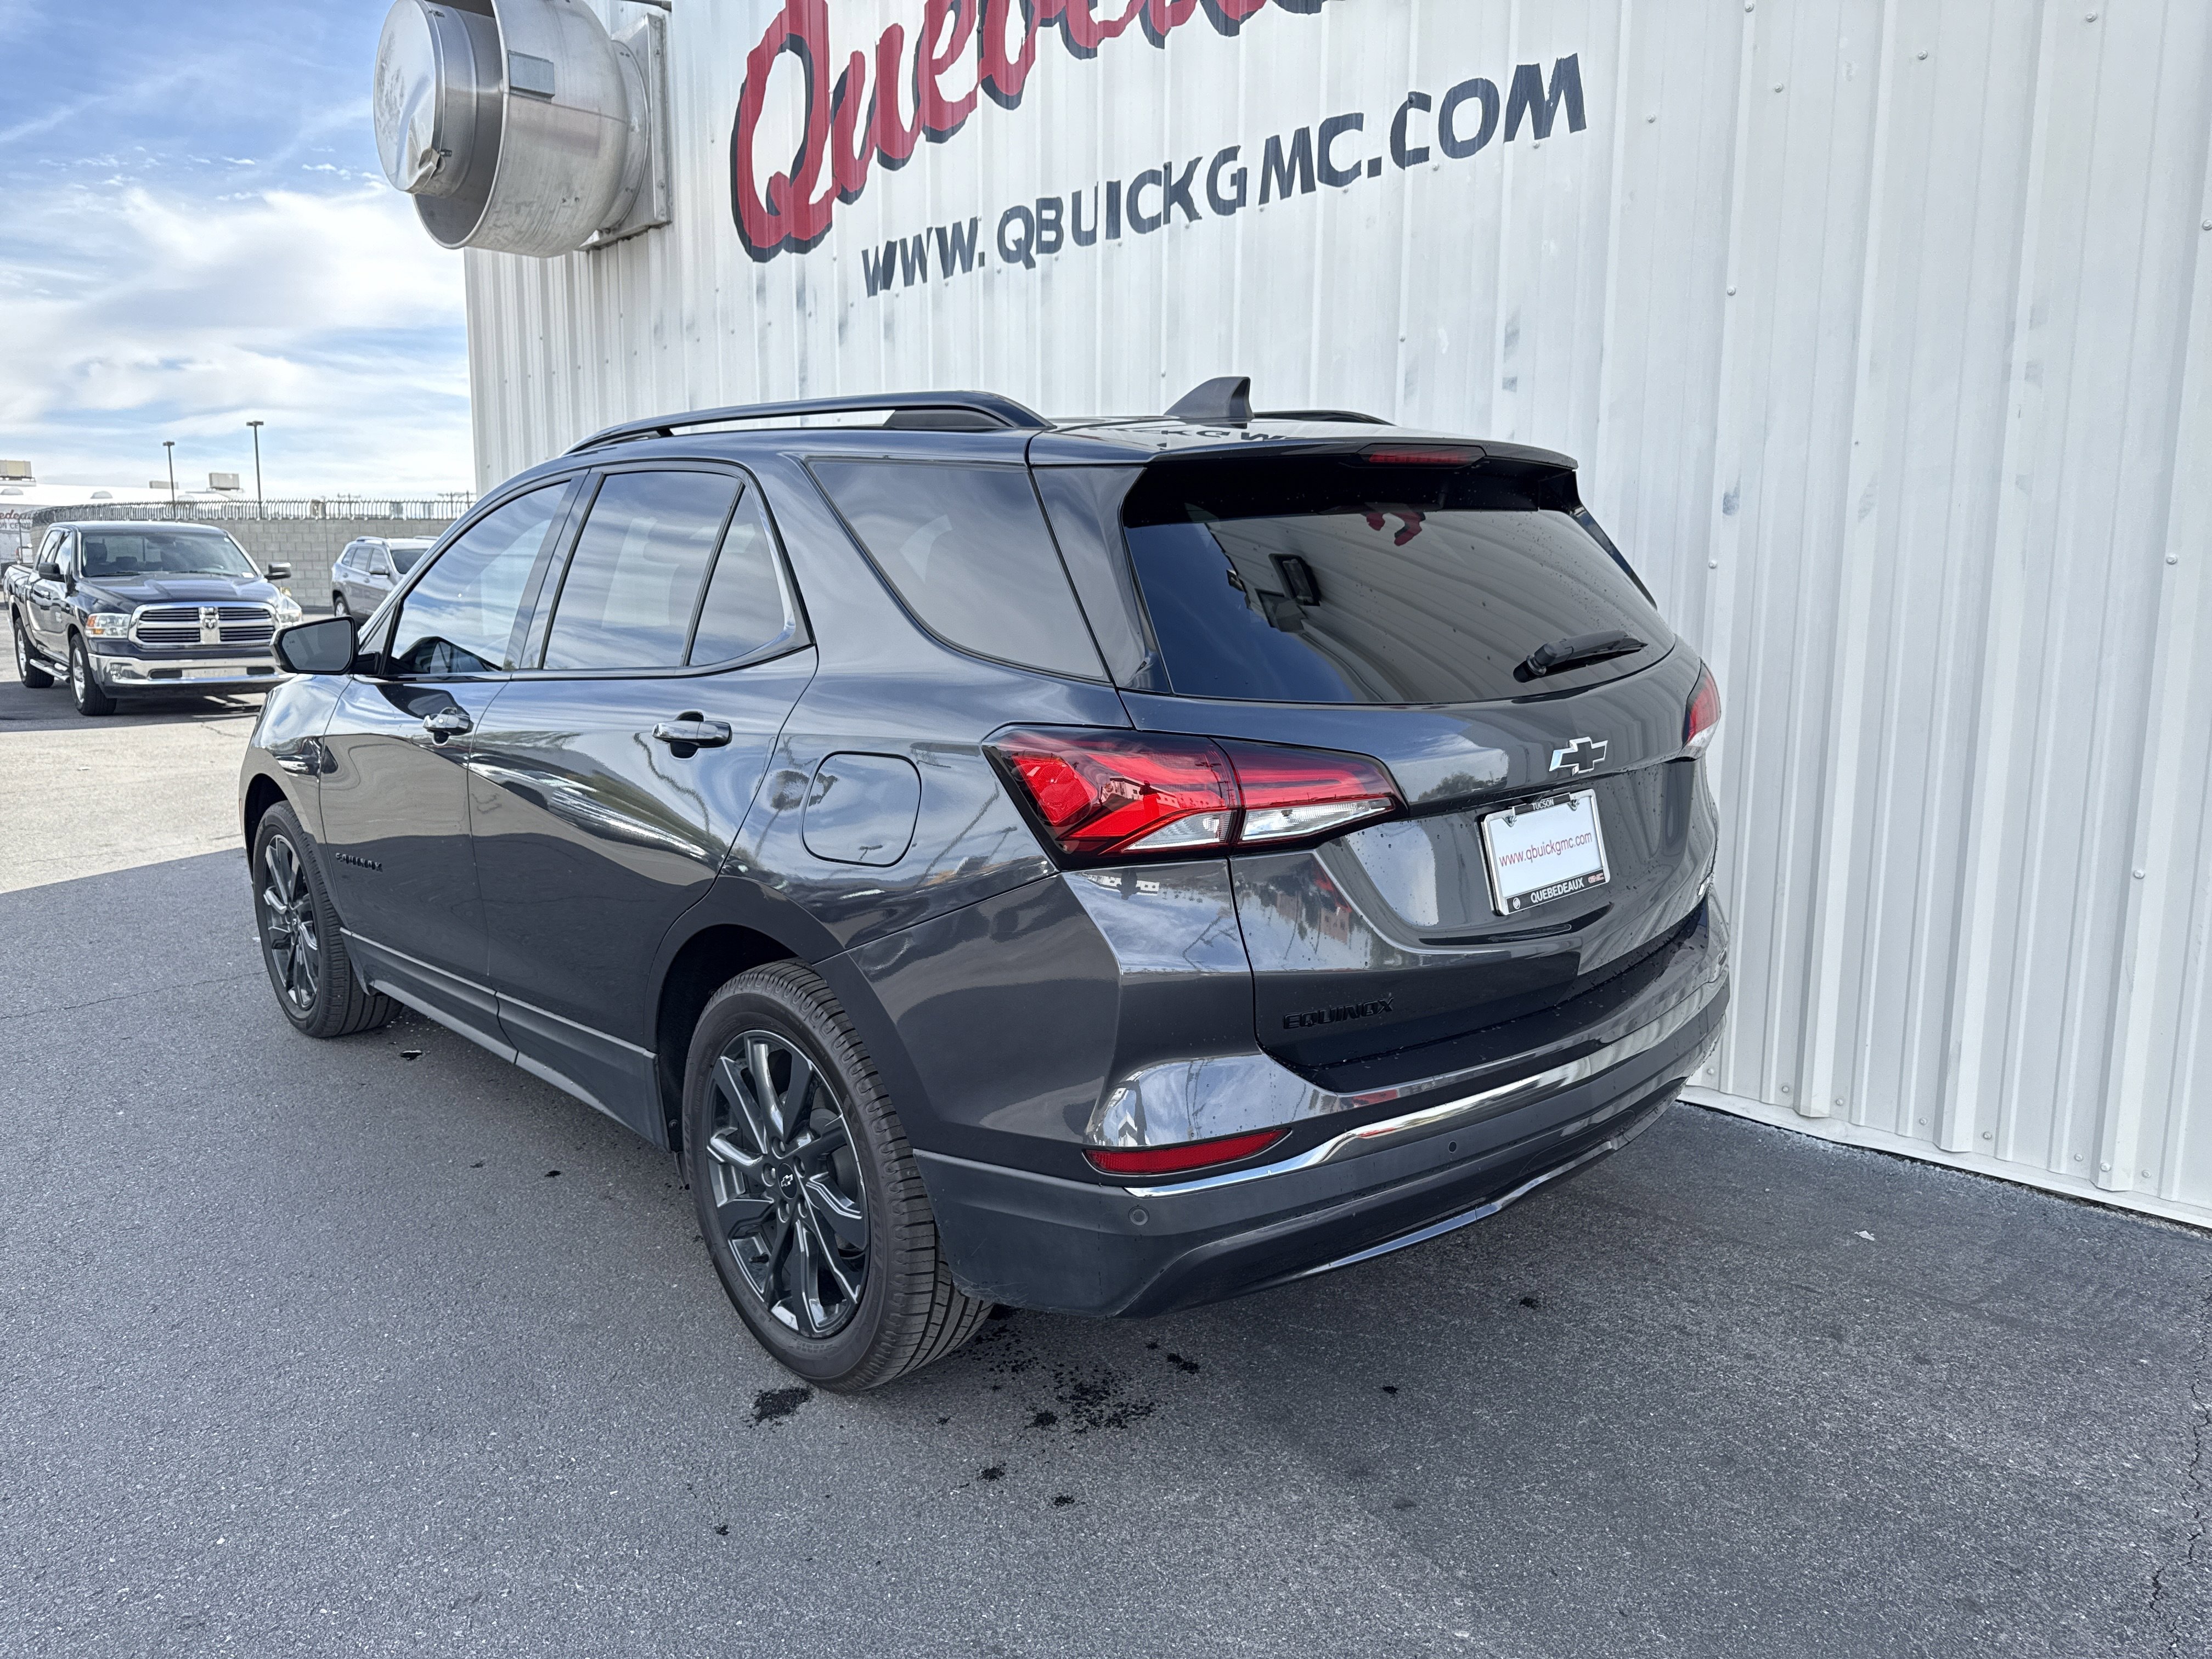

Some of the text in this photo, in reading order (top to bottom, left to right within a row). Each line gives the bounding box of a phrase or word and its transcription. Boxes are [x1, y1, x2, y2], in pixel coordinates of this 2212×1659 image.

[1531, 798, 1554, 810] TUCSON
[1499, 832, 1593, 867] www.qbuickgmc.com
[1530, 877, 1585, 904] QUEBEDEAUX
[1282, 996, 1395, 1030] EQUINOX
